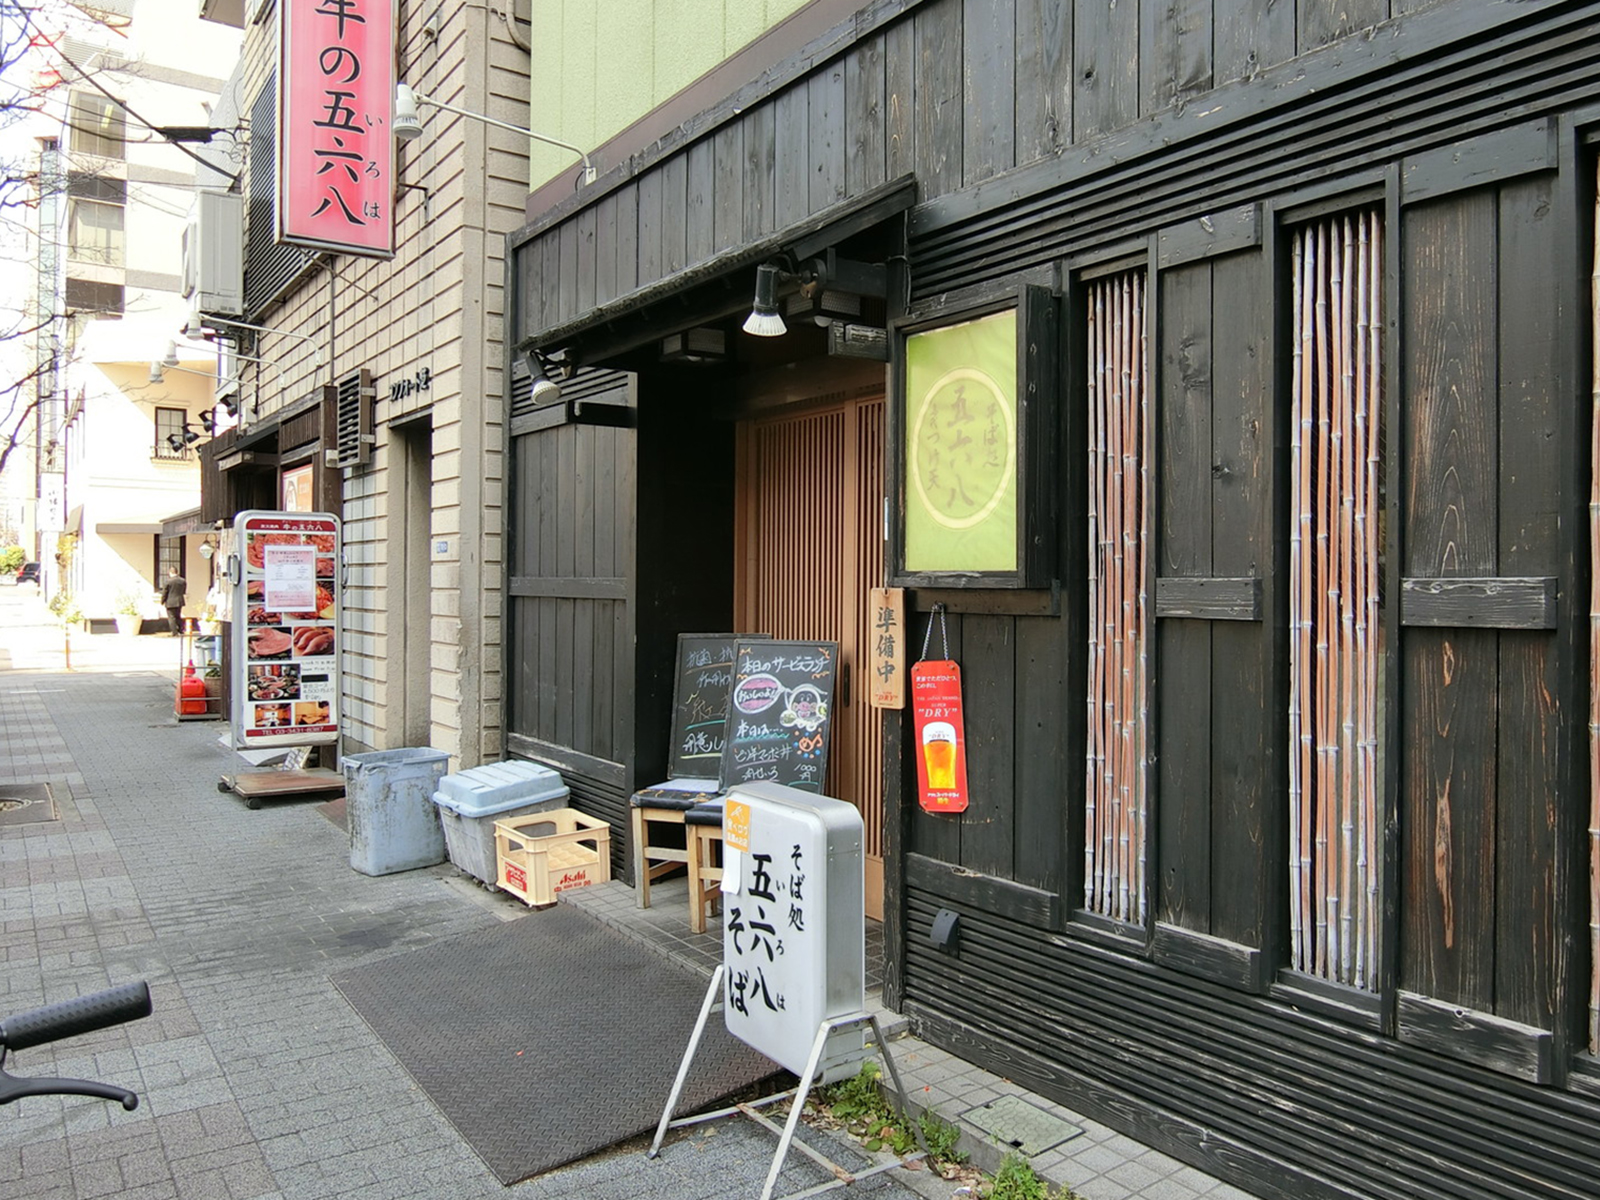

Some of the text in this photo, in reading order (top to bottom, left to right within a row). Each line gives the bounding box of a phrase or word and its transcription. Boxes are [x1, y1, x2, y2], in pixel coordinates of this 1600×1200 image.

[741, 655, 831, 674] 本日のサービスランチ
[875, 606, 898, 684] 準備中
[559, 869, 586, 885] Asahi
[788, 844, 806, 932] そば処
[727, 907, 750, 1018] そば
[748, 853, 779, 1013] 五六八
